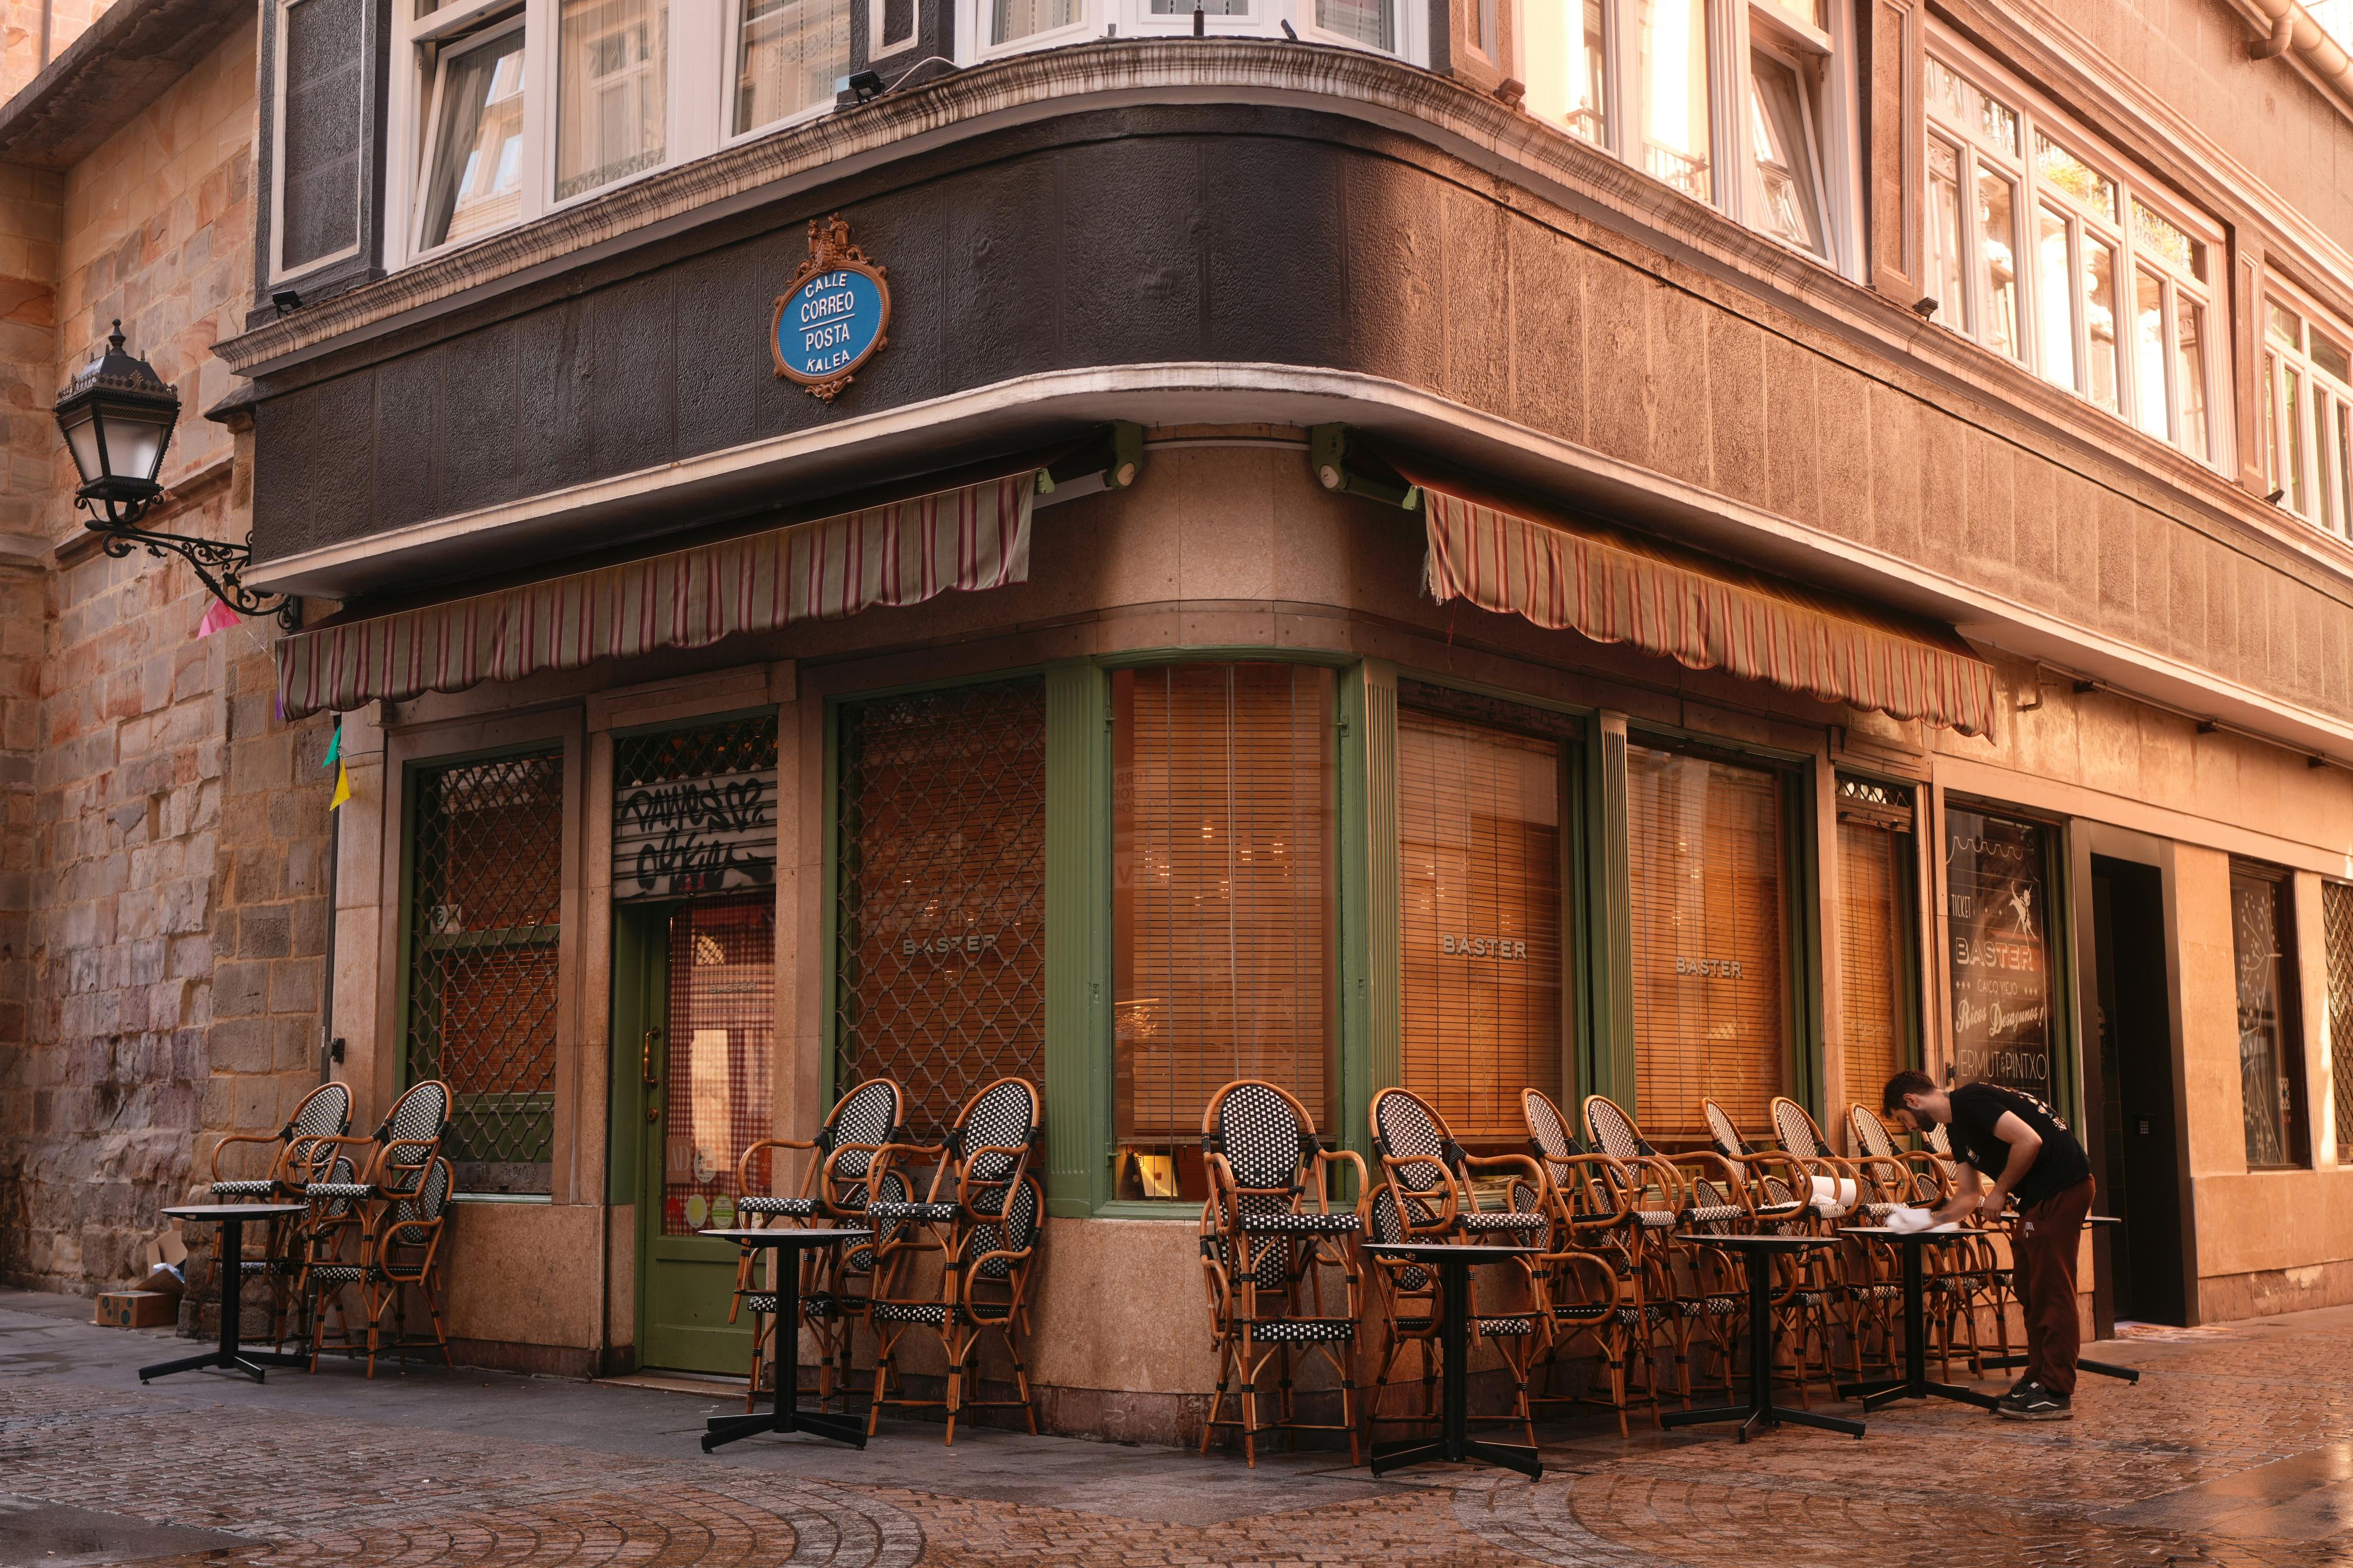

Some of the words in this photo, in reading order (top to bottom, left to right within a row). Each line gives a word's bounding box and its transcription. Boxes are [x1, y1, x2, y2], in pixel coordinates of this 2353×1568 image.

[805, 273, 848, 298] CALLE
[801, 291, 855, 323] CORREO
[805, 322, 850, 352] POSTA
[806, 349, 851, 373] KALEA
[1951, 893, 1971, 919] TICKET
[1442, 933, 1528, 960] BASTER
[1955, 937, 2034, 972] BASTER
[1675, 955, 1744, 979] BASTER
[709, 982, 756, 994] BASTER
[1999, 981, 2018, 995] VIEJO
[1955, 997, 1987, 1033] Ricos
[667, 1145, 691, 1171] AD
